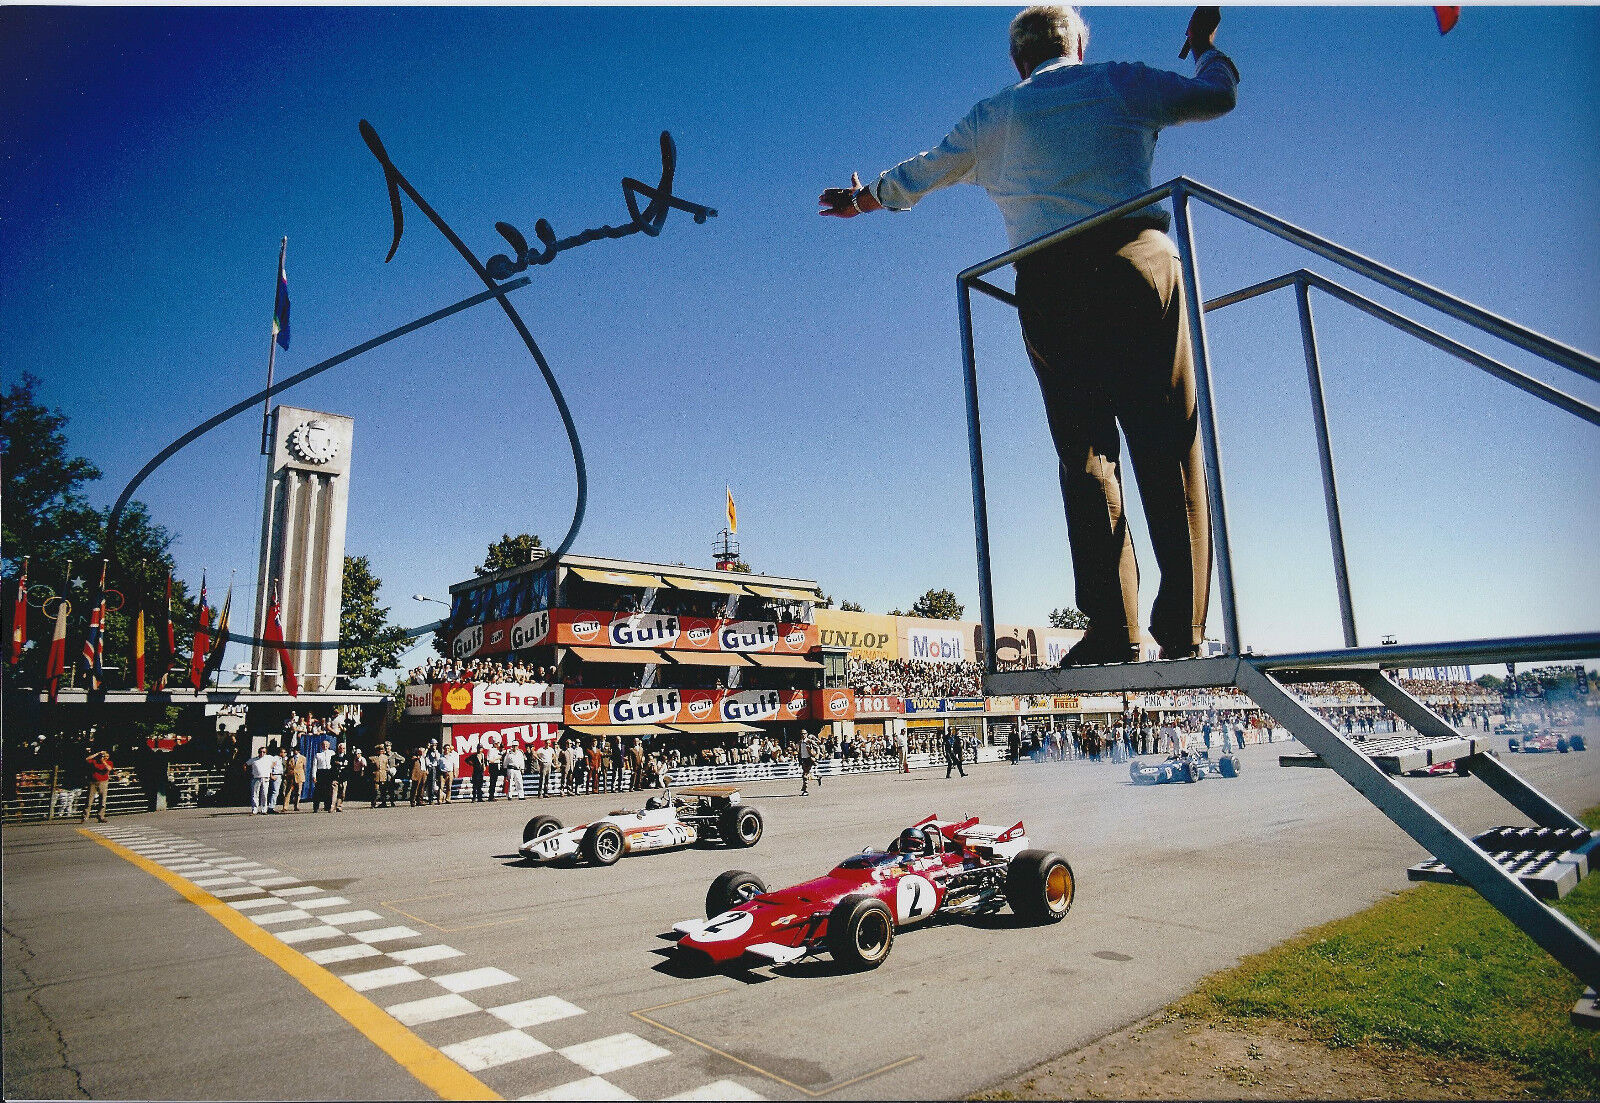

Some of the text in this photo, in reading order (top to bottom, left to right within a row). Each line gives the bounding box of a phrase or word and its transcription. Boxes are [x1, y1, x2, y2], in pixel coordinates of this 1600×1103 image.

[513, 613, 547, 649] Gulf
[573, 621, 600, 633] Gulf
[613, 618, 677, 644] Gulf
[688, 628, 711, 639] Gulf
[722, 624, 775, 649] Gulf
[454, 626, 482, 657] Gulf
[785, 632, 804, 645] Gulf
[913, 635, 961, 659] Mobil
[406, 692, 432, 708] Shell
[484, 691, 555, 707] Shell
[573, 701, 600, 713] Gulf
[613, 691, 678, 722] Gulf
[689, 700, 712, 712] Gulf
[724, 691, 778, 720] Gulf
[830, 699, 849, 710] Gulf
[455, 723, 557, 755] MOTUL
[543, 839, 559, 852] 10
[906, 882, 923, 918] 2
[704, 911, 747, 933] 2
